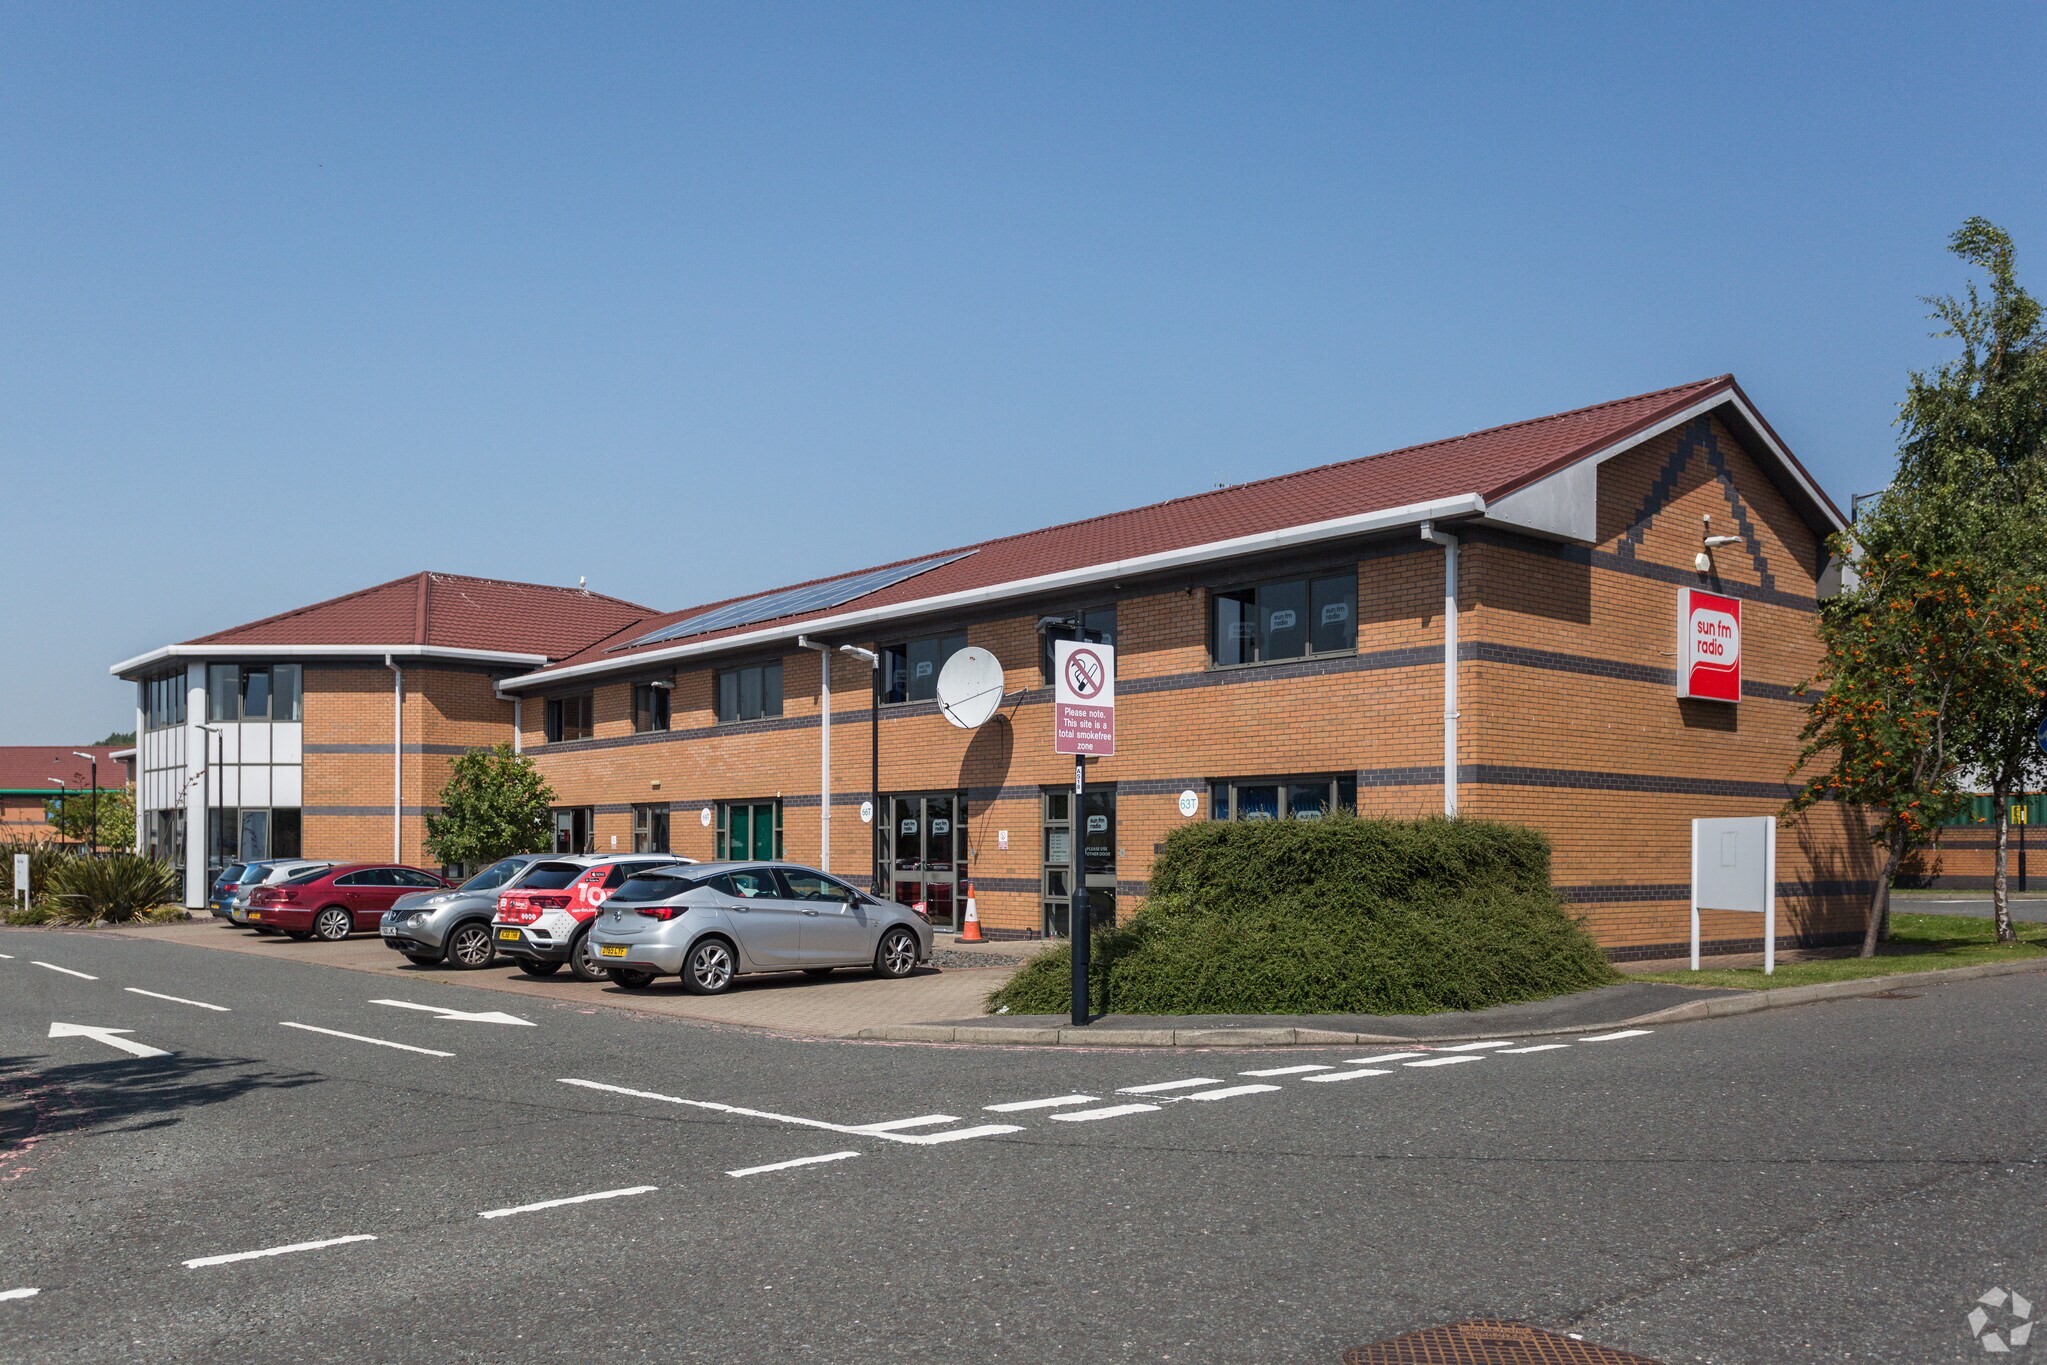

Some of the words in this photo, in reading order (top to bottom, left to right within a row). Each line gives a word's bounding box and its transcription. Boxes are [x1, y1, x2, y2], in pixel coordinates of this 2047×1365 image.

[1697, 621, 1715, 635] sun
[1718, 620, 1732, 638] fm
[1697, 638, 1724, 656] radio
[1064, 707, 1087, 717] Please
[1088, 710, 1106, 719] note.
[1063, 717, 1077, 728] This
[1079, 720, 1092, 729] site
[1094, 721, 1100, 729] is
[1058, 729, 1074, 738] total
[1076, 731, 1112, 740] smokefree
[1077, 742, 1093, 750] zone
[1180, 798, 1197, 810] 63T
[862, 808, 871, 816] 66T
